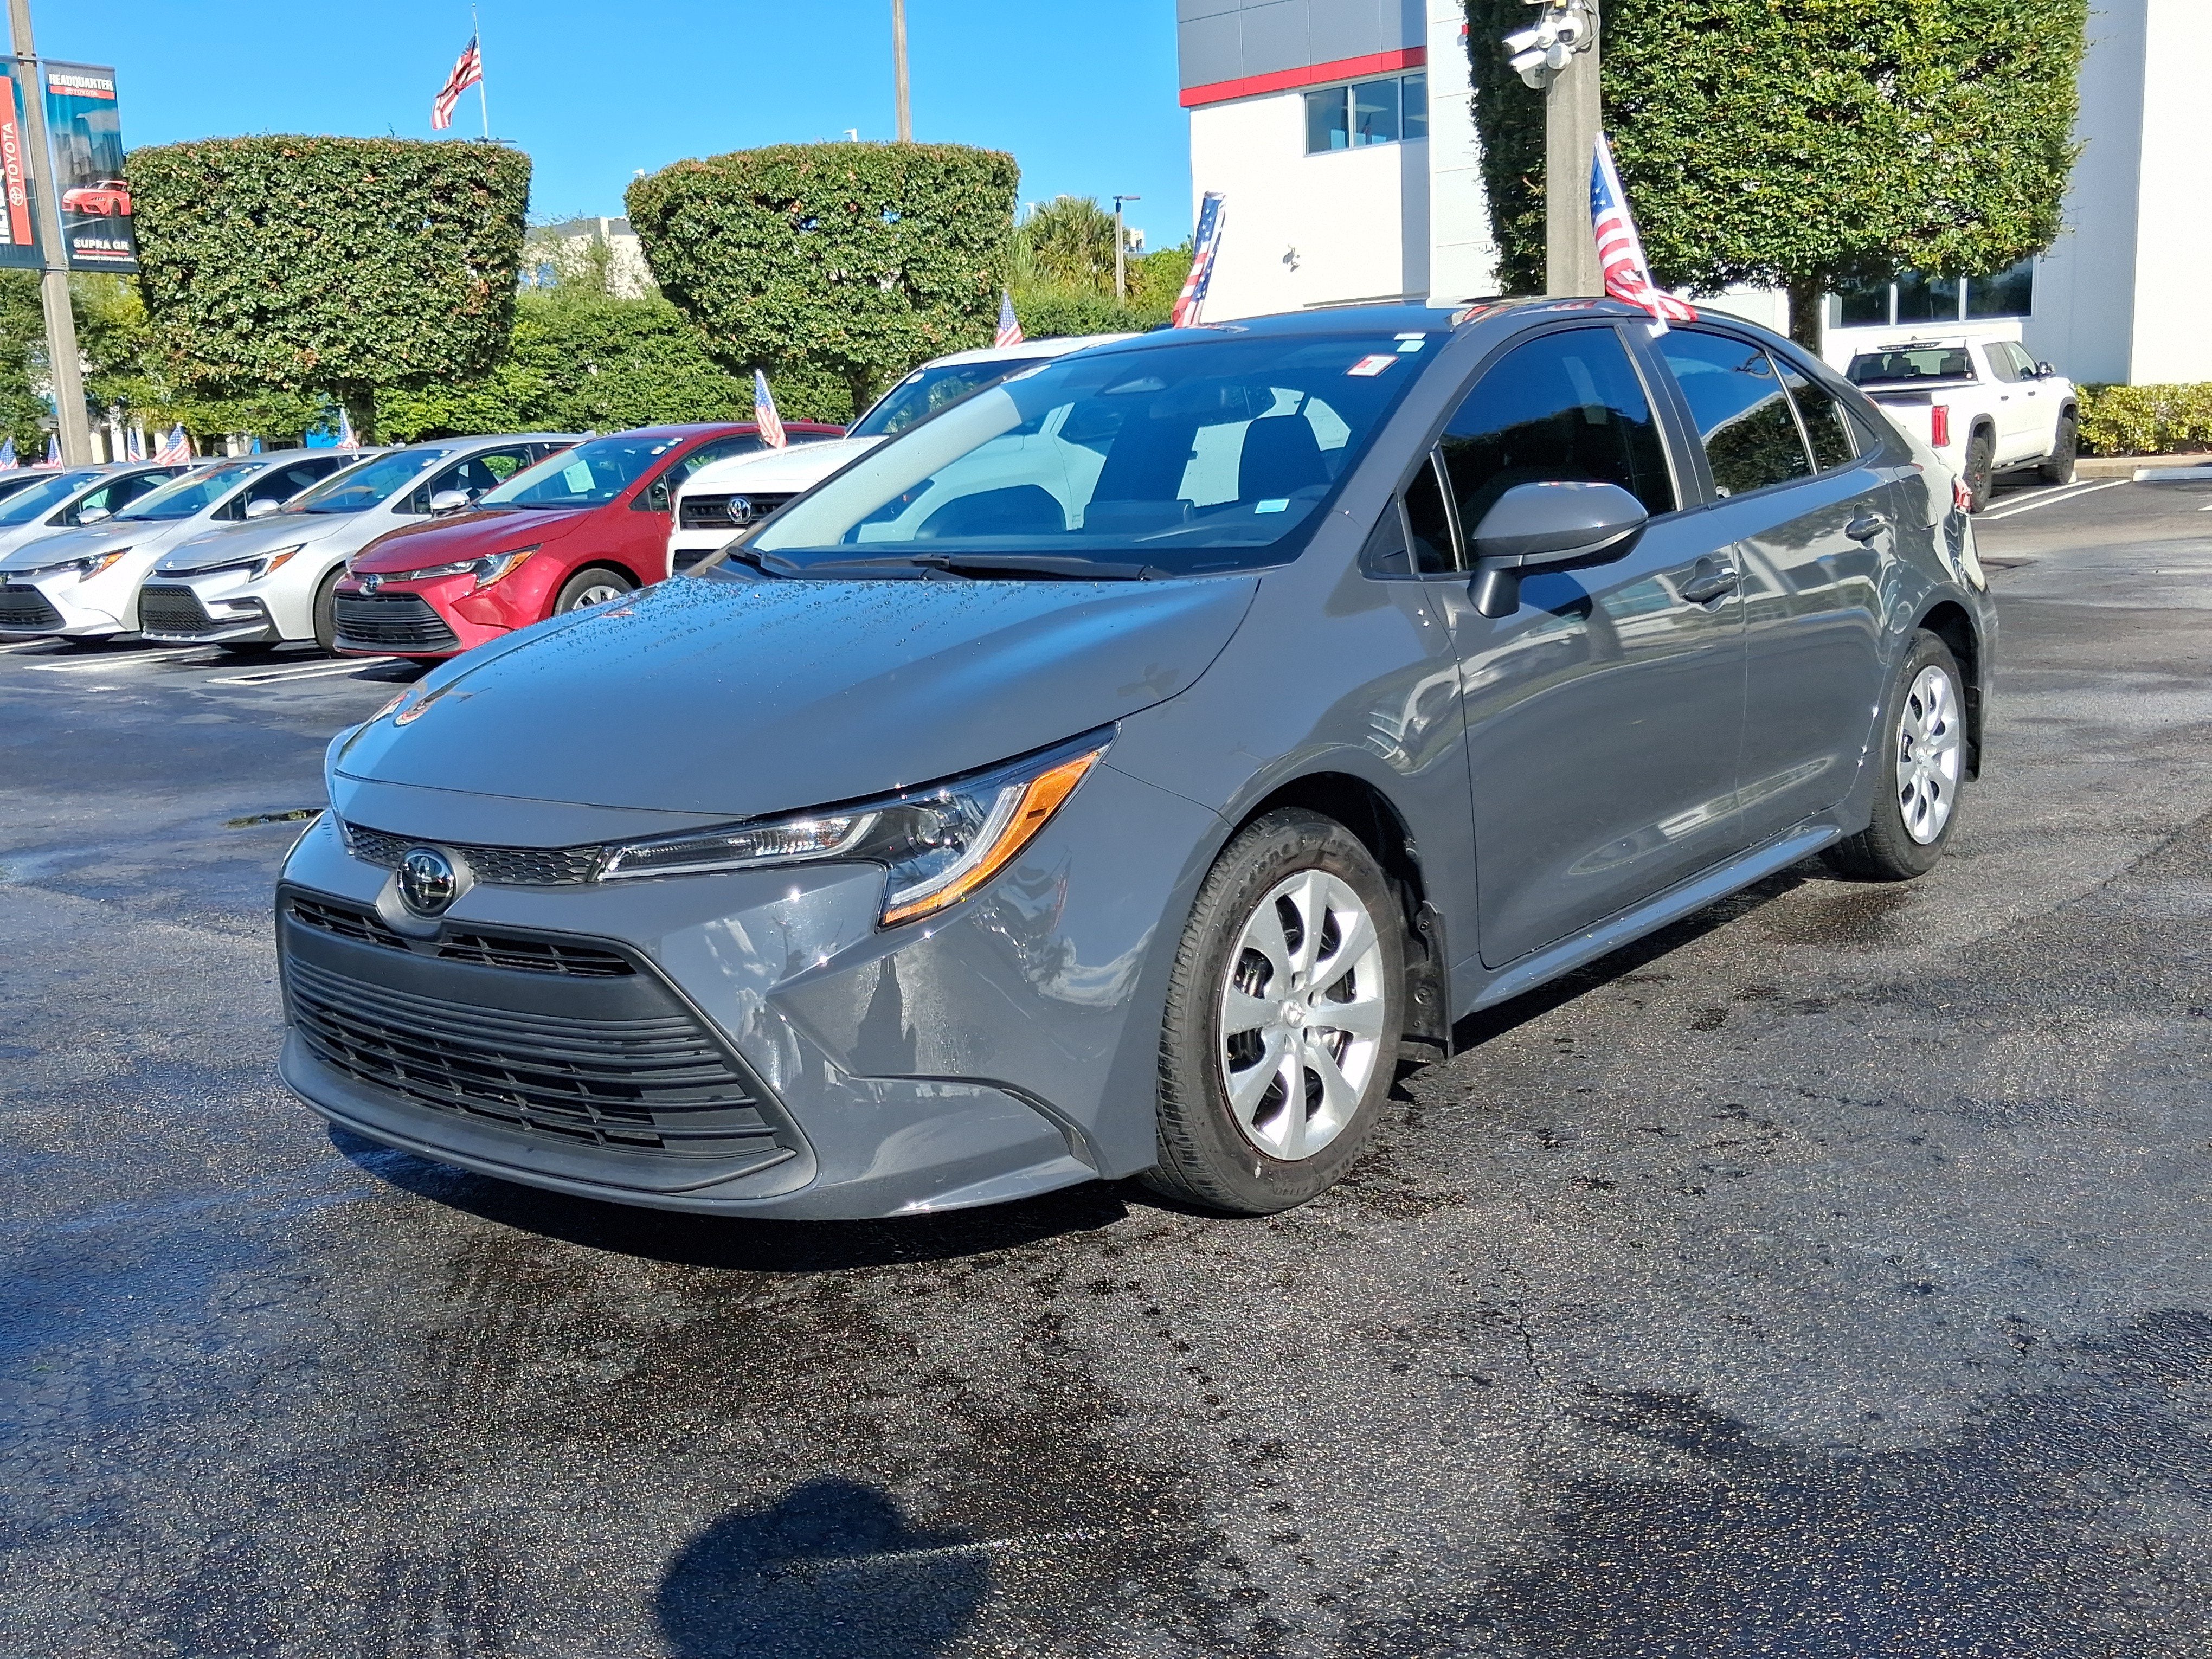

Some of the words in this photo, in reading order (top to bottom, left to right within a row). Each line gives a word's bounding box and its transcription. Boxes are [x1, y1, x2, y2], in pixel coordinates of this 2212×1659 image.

[49, 74, 113, 91] HEADQUARTER
[2, 121, 20, 185] TOYOTA
[73, 239, 111, 249] SUPRA
[112, 240, 130, 250] GR
